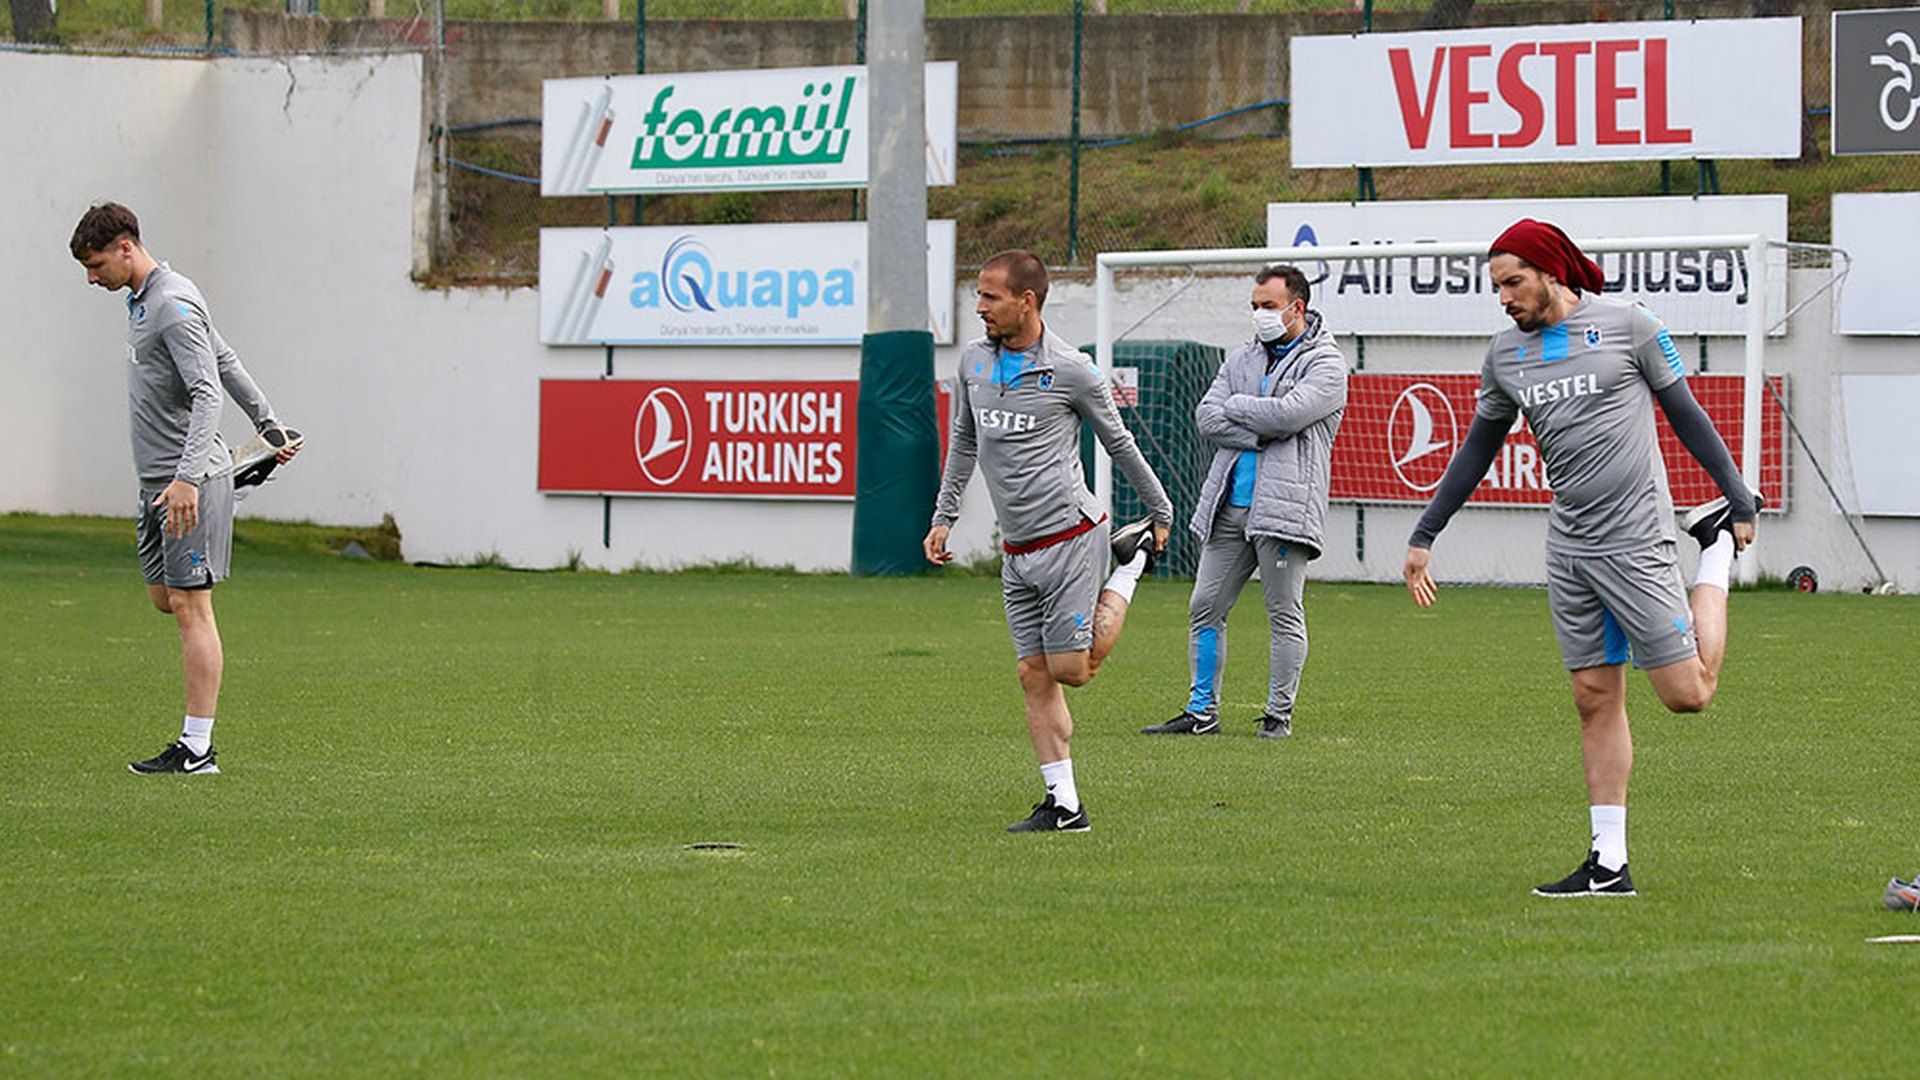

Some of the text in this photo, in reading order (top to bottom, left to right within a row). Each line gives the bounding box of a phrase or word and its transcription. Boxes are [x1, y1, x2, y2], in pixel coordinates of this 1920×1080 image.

[632, 76, 857, 168] formül
[1387, 37, 1693, 149] VESTEL
[629, 235, 855, 318] aQuapa
[704, 391, 843, 434] TURKISH
[1518, 373, 1604, 407] VESTEL
[701, 441, 844, 485] AIRLINES
